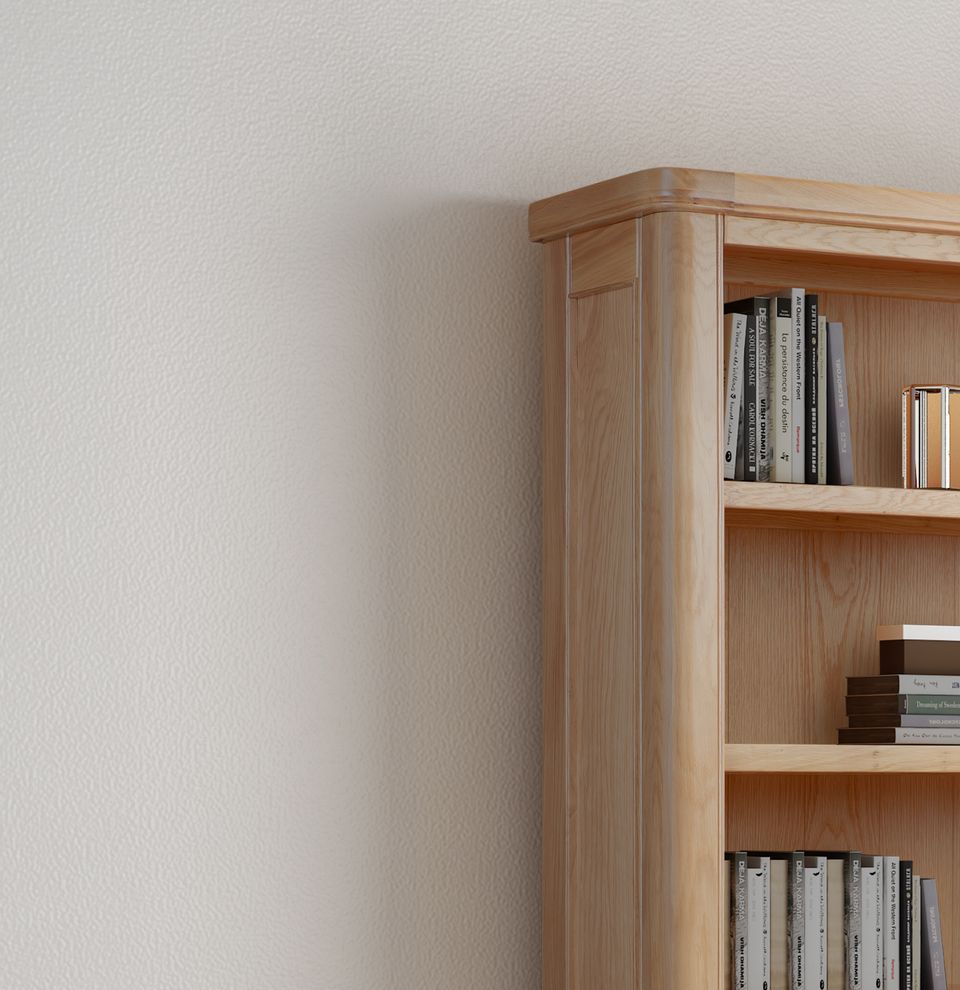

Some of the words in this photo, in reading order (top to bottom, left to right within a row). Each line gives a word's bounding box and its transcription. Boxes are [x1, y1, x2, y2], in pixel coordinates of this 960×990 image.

[796, 328, 802, 337] on
[780, 345, 789, 393] persistance
[781, 395, 789, 406] du
[781, 408, 789, 433] destin
